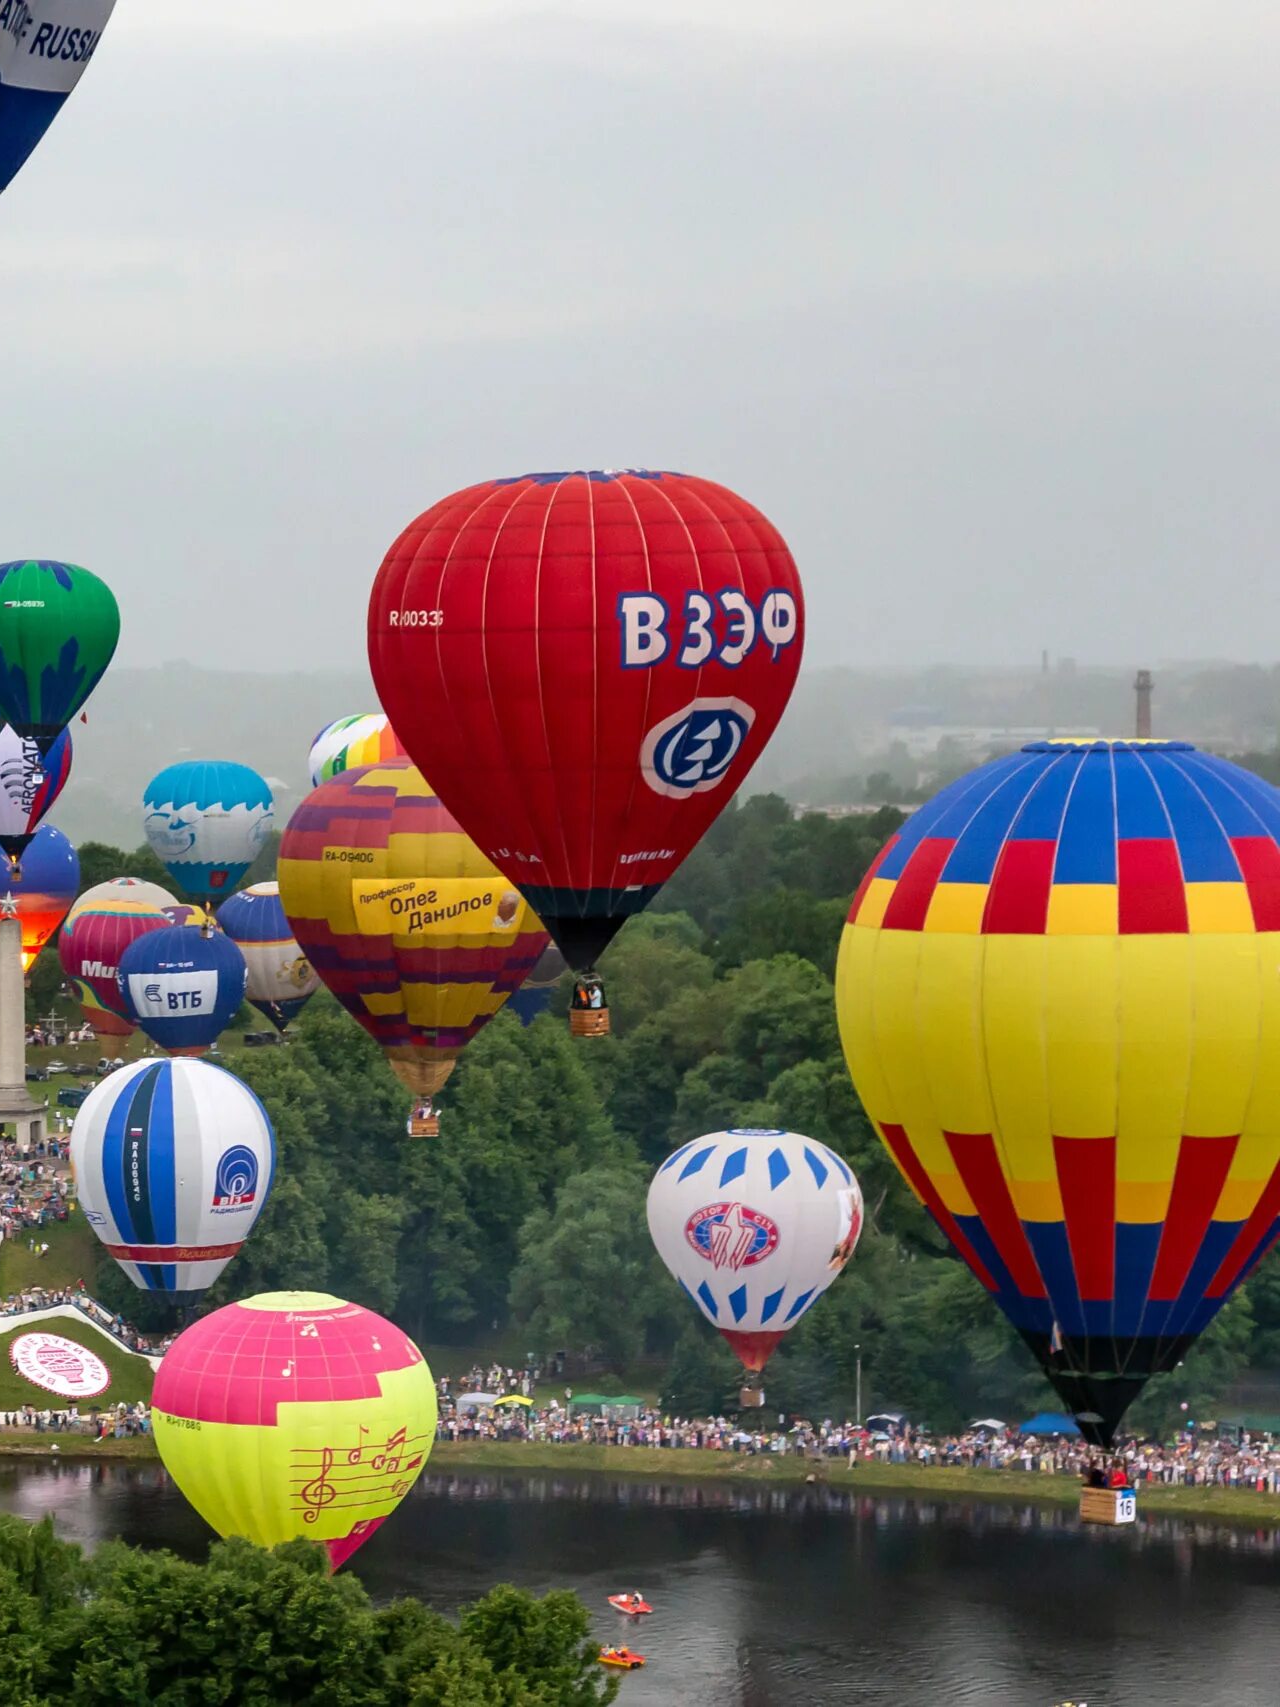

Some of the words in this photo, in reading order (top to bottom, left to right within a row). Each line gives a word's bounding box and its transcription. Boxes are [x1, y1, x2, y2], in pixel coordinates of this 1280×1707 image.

[29, 22, 101, 62] RUSSIA
[619, 589, 798, 667] ВЗЭФ
[21, 733, 39, 816] AERONAT
[325, 851, 374, 863] RA-0940G
[359, 881, 416, 905] Профессор
[390, 890, 438, 915] Олег
[408, 892, 493, 934] Данилов
[167, 990, 203, 1010] ВТБ
[1120, 1500, 1132, 1516] 16
